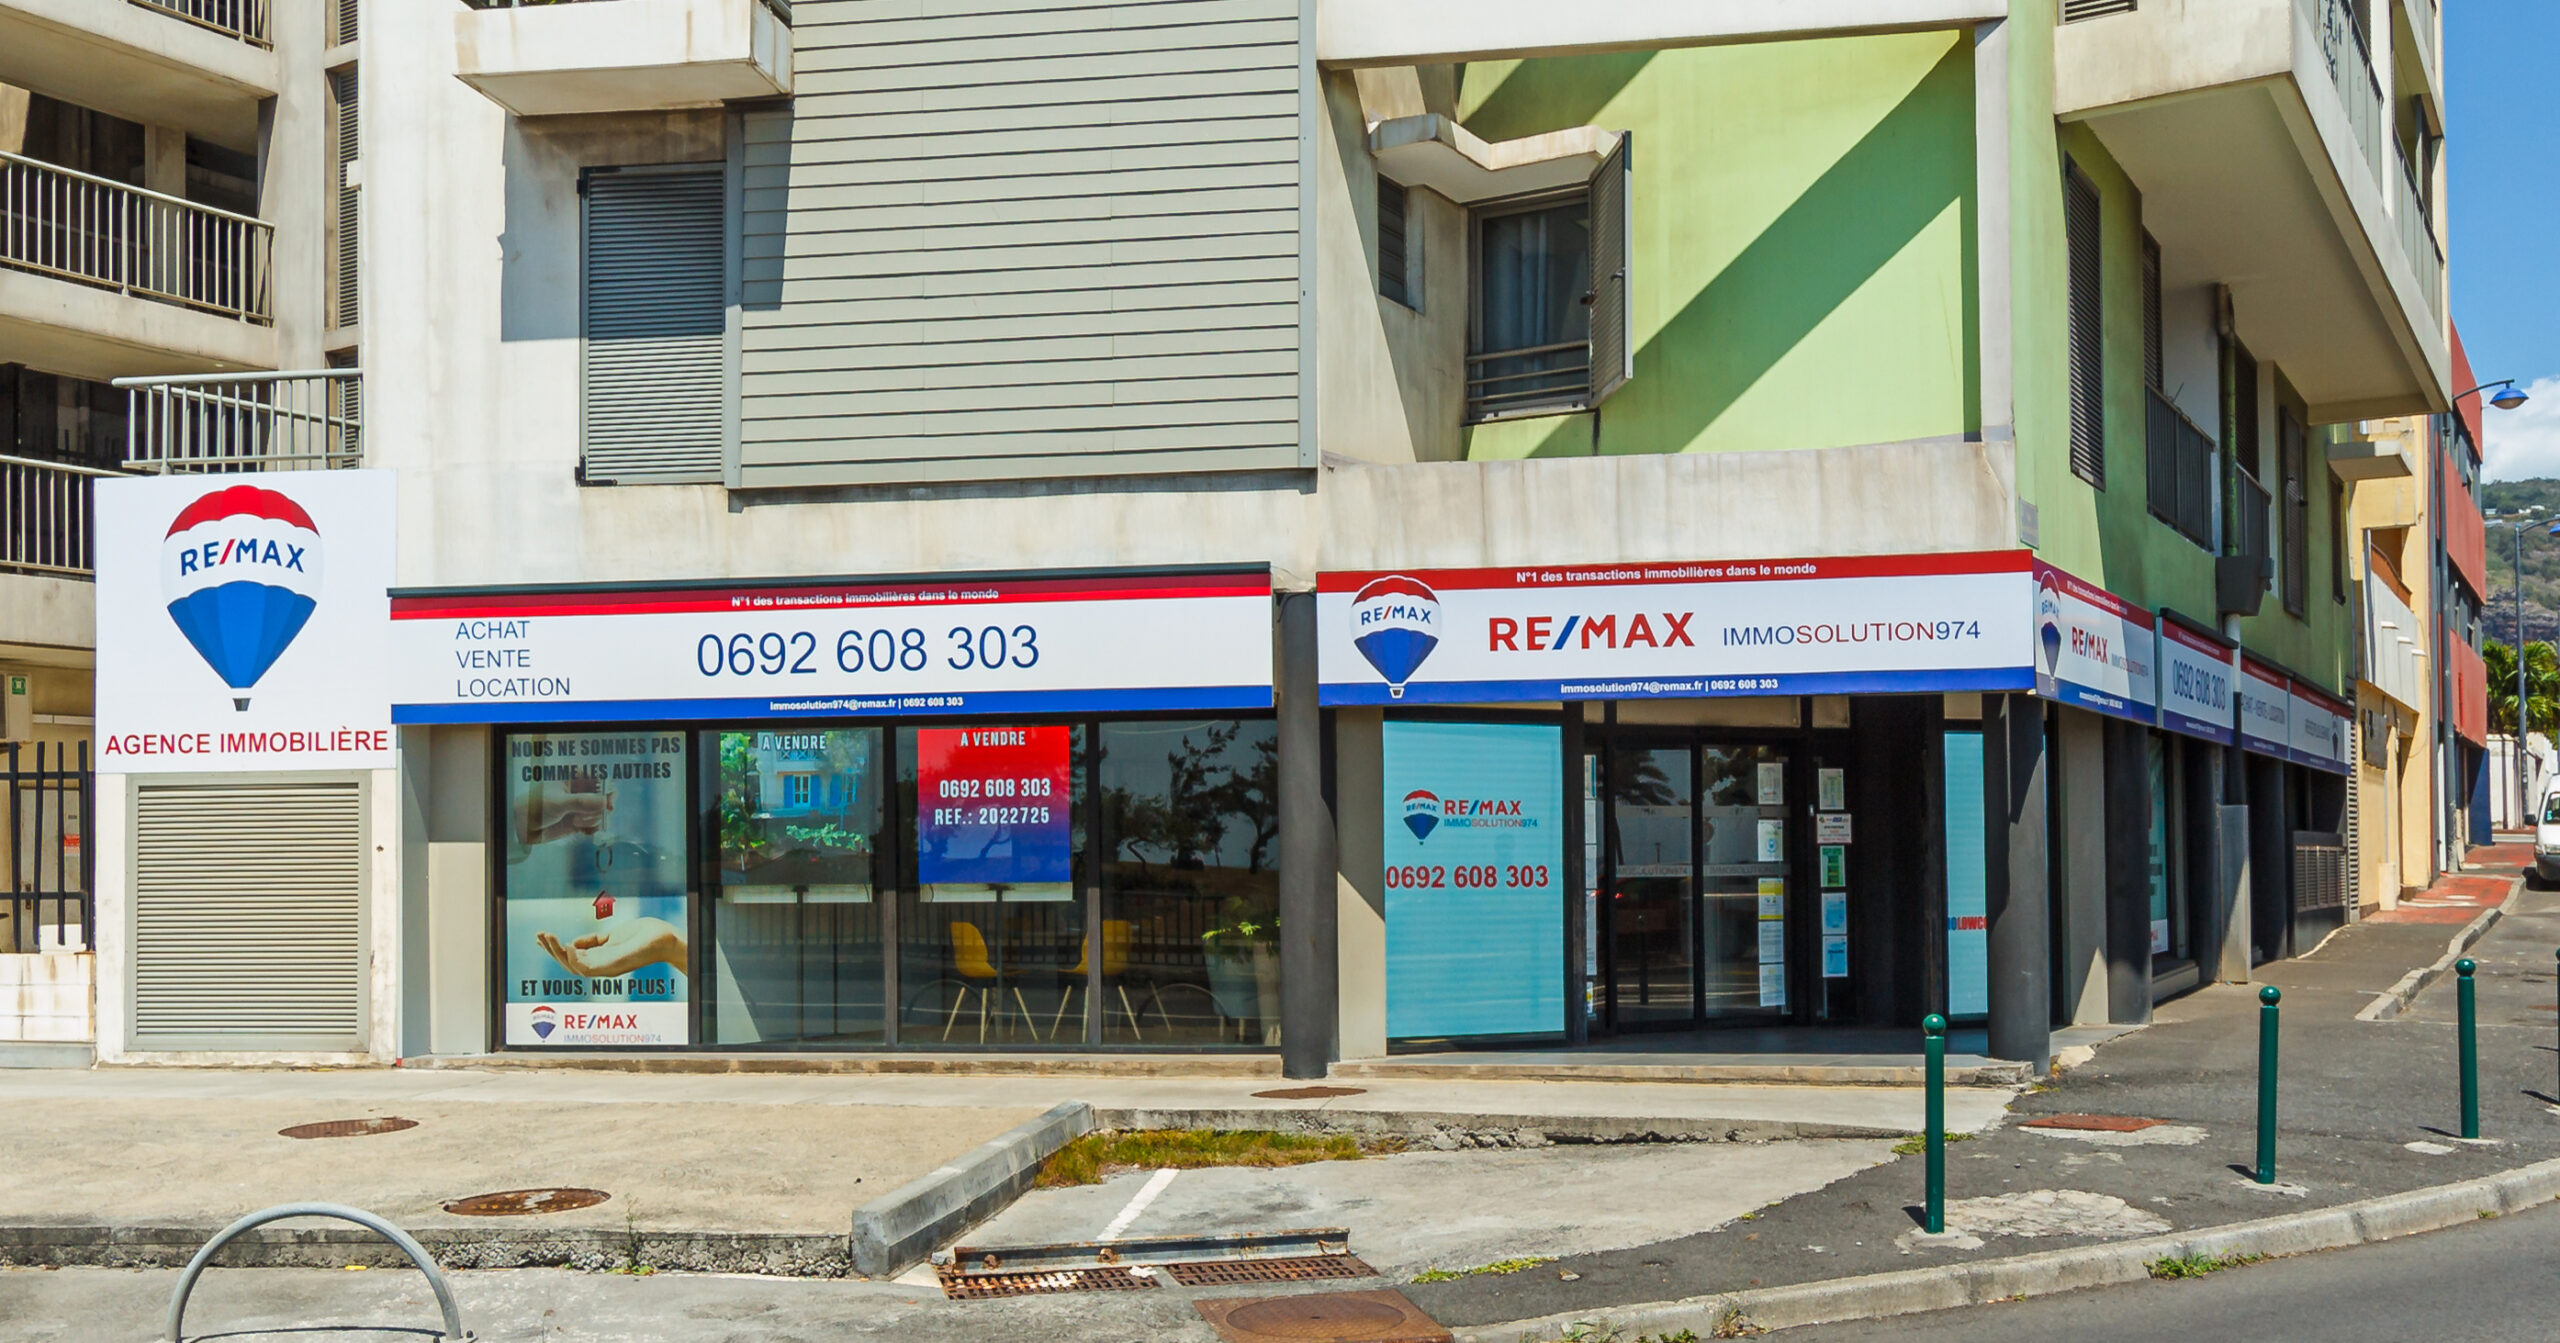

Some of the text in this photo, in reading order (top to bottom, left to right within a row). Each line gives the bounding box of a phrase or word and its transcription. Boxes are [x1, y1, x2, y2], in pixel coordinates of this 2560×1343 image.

[180, 538, 305, 577] RE/MAX
[1516, 563, 1817, 583] N°1 des transactions immobilières dans le monde
[731, 588, 999, 607] N°1 des transactions immobilières dans le monde
[1361, 605, 1432, 626] RE/MAX
[456, 620, 531, 640] ACHAT
[1489, 611, 1981, 652] RE/MAX IMMOSOLUTION974
[697, 625, 1040, 677] 0692 608 303
[2072, 626, 2108, 665] RE/MAX
[456, 649, 531, 669] VENTE
[457, 678, 571, 698] LOCATION
[1560, 681, 1702, 694] immosolution974@remax.fr
[1711, 680, 1736, 691] 0692
[1738, 680, 1757, 690] 608
[1759, 679, 1779, 689] 303
[903, 698, 926, 708] 0692
[927, 698, 944, 707] 608
[946, 697, 964, 706] 303
[105, 726, 389, 755] AGENCE IMMOBILIÈRE
[512, 737, 681, 757] NOUS NE SOMMES PAS
[762, 735, 826, 750] A VENDRE
[960, 731, 1026, 746] A VENDRE
[522, 762, 671, 782] COMME LES AUTRES
[939, 778, 1051, 798] 0692 608 303
[934, 807, 1050, 825] REF.: 2022725
[1444, 800, 1522, 815] RE/MAX
[1444, 818, 1538, 828] IMMOSOLUTION974
[1386, 865, 1549, 889] 0692 608 303
[521, 980, 537, 996] ET
[592, 979, 623, 995] NON
[628, 978, 666, 994] PLUS
[564, 1014, 638, 1029] RE/MAX
[563, 1034, 662, 1043] IMMOSOLUTION974
